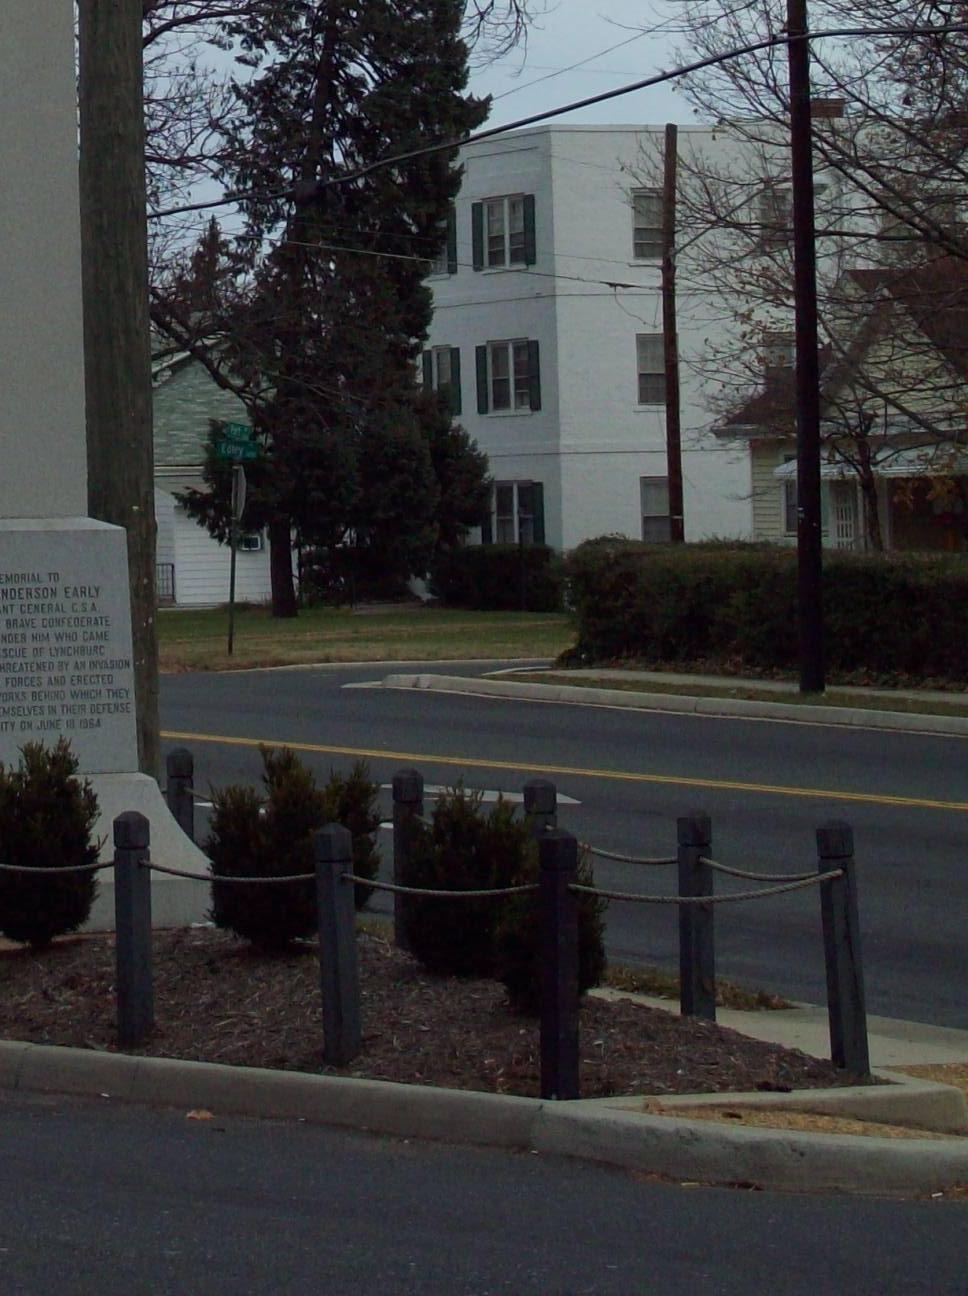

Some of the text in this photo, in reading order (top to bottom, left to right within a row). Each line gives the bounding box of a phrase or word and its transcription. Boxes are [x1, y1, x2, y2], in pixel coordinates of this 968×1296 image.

[48, 572, 60, 582] TO
[64, 585, 101, 599] EARLY
[20, 602, 66, 615] GENERAL
[6, 618, 36, 630] BRAVE
[42, 616, 111, 629] CONFEDERATE
[32, 632, 50, 642] HIM
[54, 632, 78, 642] WHO
[82, 631, 110, 642] CAME
[32, 647, 44, 658] OF
[49, 646, 105, 657] LYNCHBURG
[58, 661, 68, 672] BY
[74, 660, 86, 670] AN
[89, 660, 130, 670] INVASION
[5, 676, 42, 688] FORCES
[47, 676, 66, 686] AND
[70, 674, 114, 686] ERECTED
[32, 690, 66, 702] BEHIND
[70, 689, 102, 700] WHICH
[105, 688, 130, 699] THEY
[48, 704, 56, 715] IN
[60, 704, 86, 714] THEIR
[90, 702, 131, 714] DEFENSE
[20, 720, 32, 731] ON
[36, 719, 62, 730] JUNE
